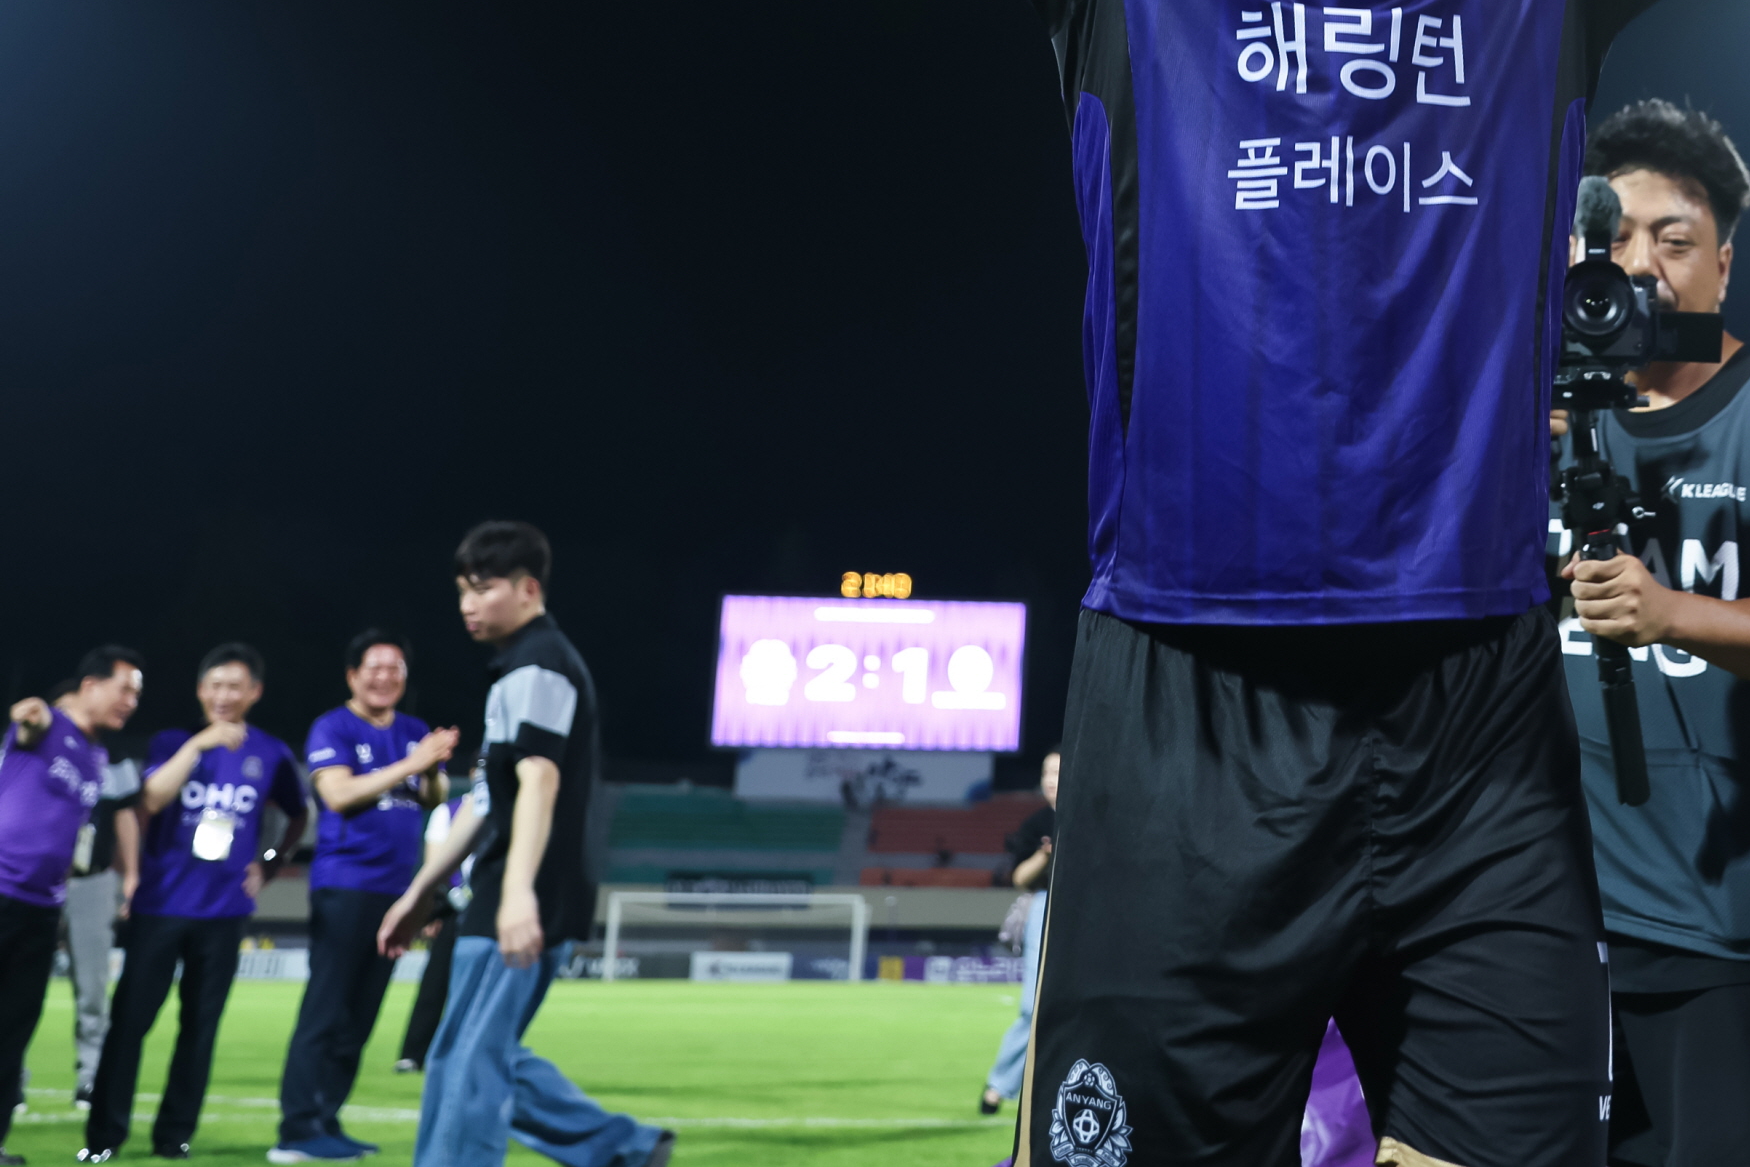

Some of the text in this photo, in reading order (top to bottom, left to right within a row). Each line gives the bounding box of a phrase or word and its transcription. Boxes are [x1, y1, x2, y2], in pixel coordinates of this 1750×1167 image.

[1236, 1, 1472, 107] 해링턴
[1227, 135, 1478, 213] 플레이스
[804, 643, 929, 704] 2:1
[1066, 1092, 1112, 1110] ANYANG
